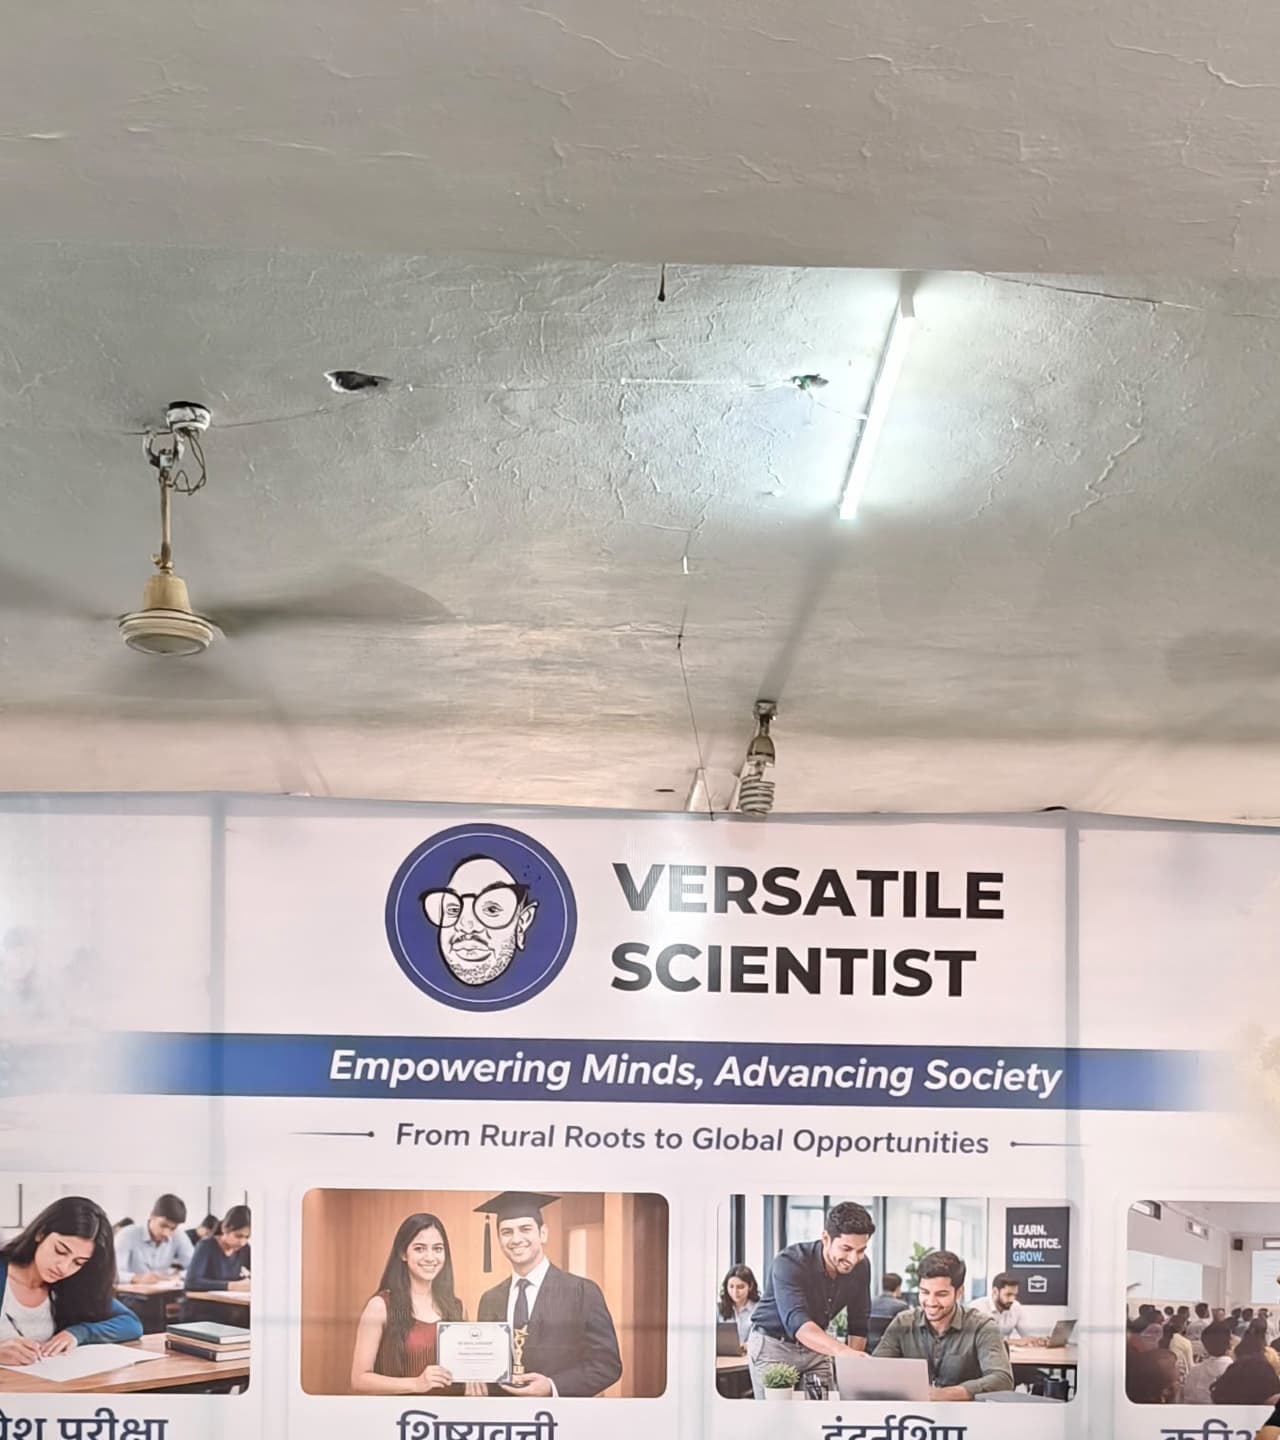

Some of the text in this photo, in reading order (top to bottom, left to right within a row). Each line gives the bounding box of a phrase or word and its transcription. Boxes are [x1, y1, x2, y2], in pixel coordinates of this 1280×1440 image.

[611, 862, 1005, 920] VERSATILE
[610, 942, 977, 998] SCIENTIST
[328, 1048, 1063, 1096] Empowering Minds, Advancing Society
[396, 1122, 989, 1158] From Rural Roots to Global Opportunities
[1012, 1224, 1047, 1236] LEARN.
[1012, 1237, 1062, 1249] PRACTICE.
[1012, 1250, 1045, 1263] GROW.
